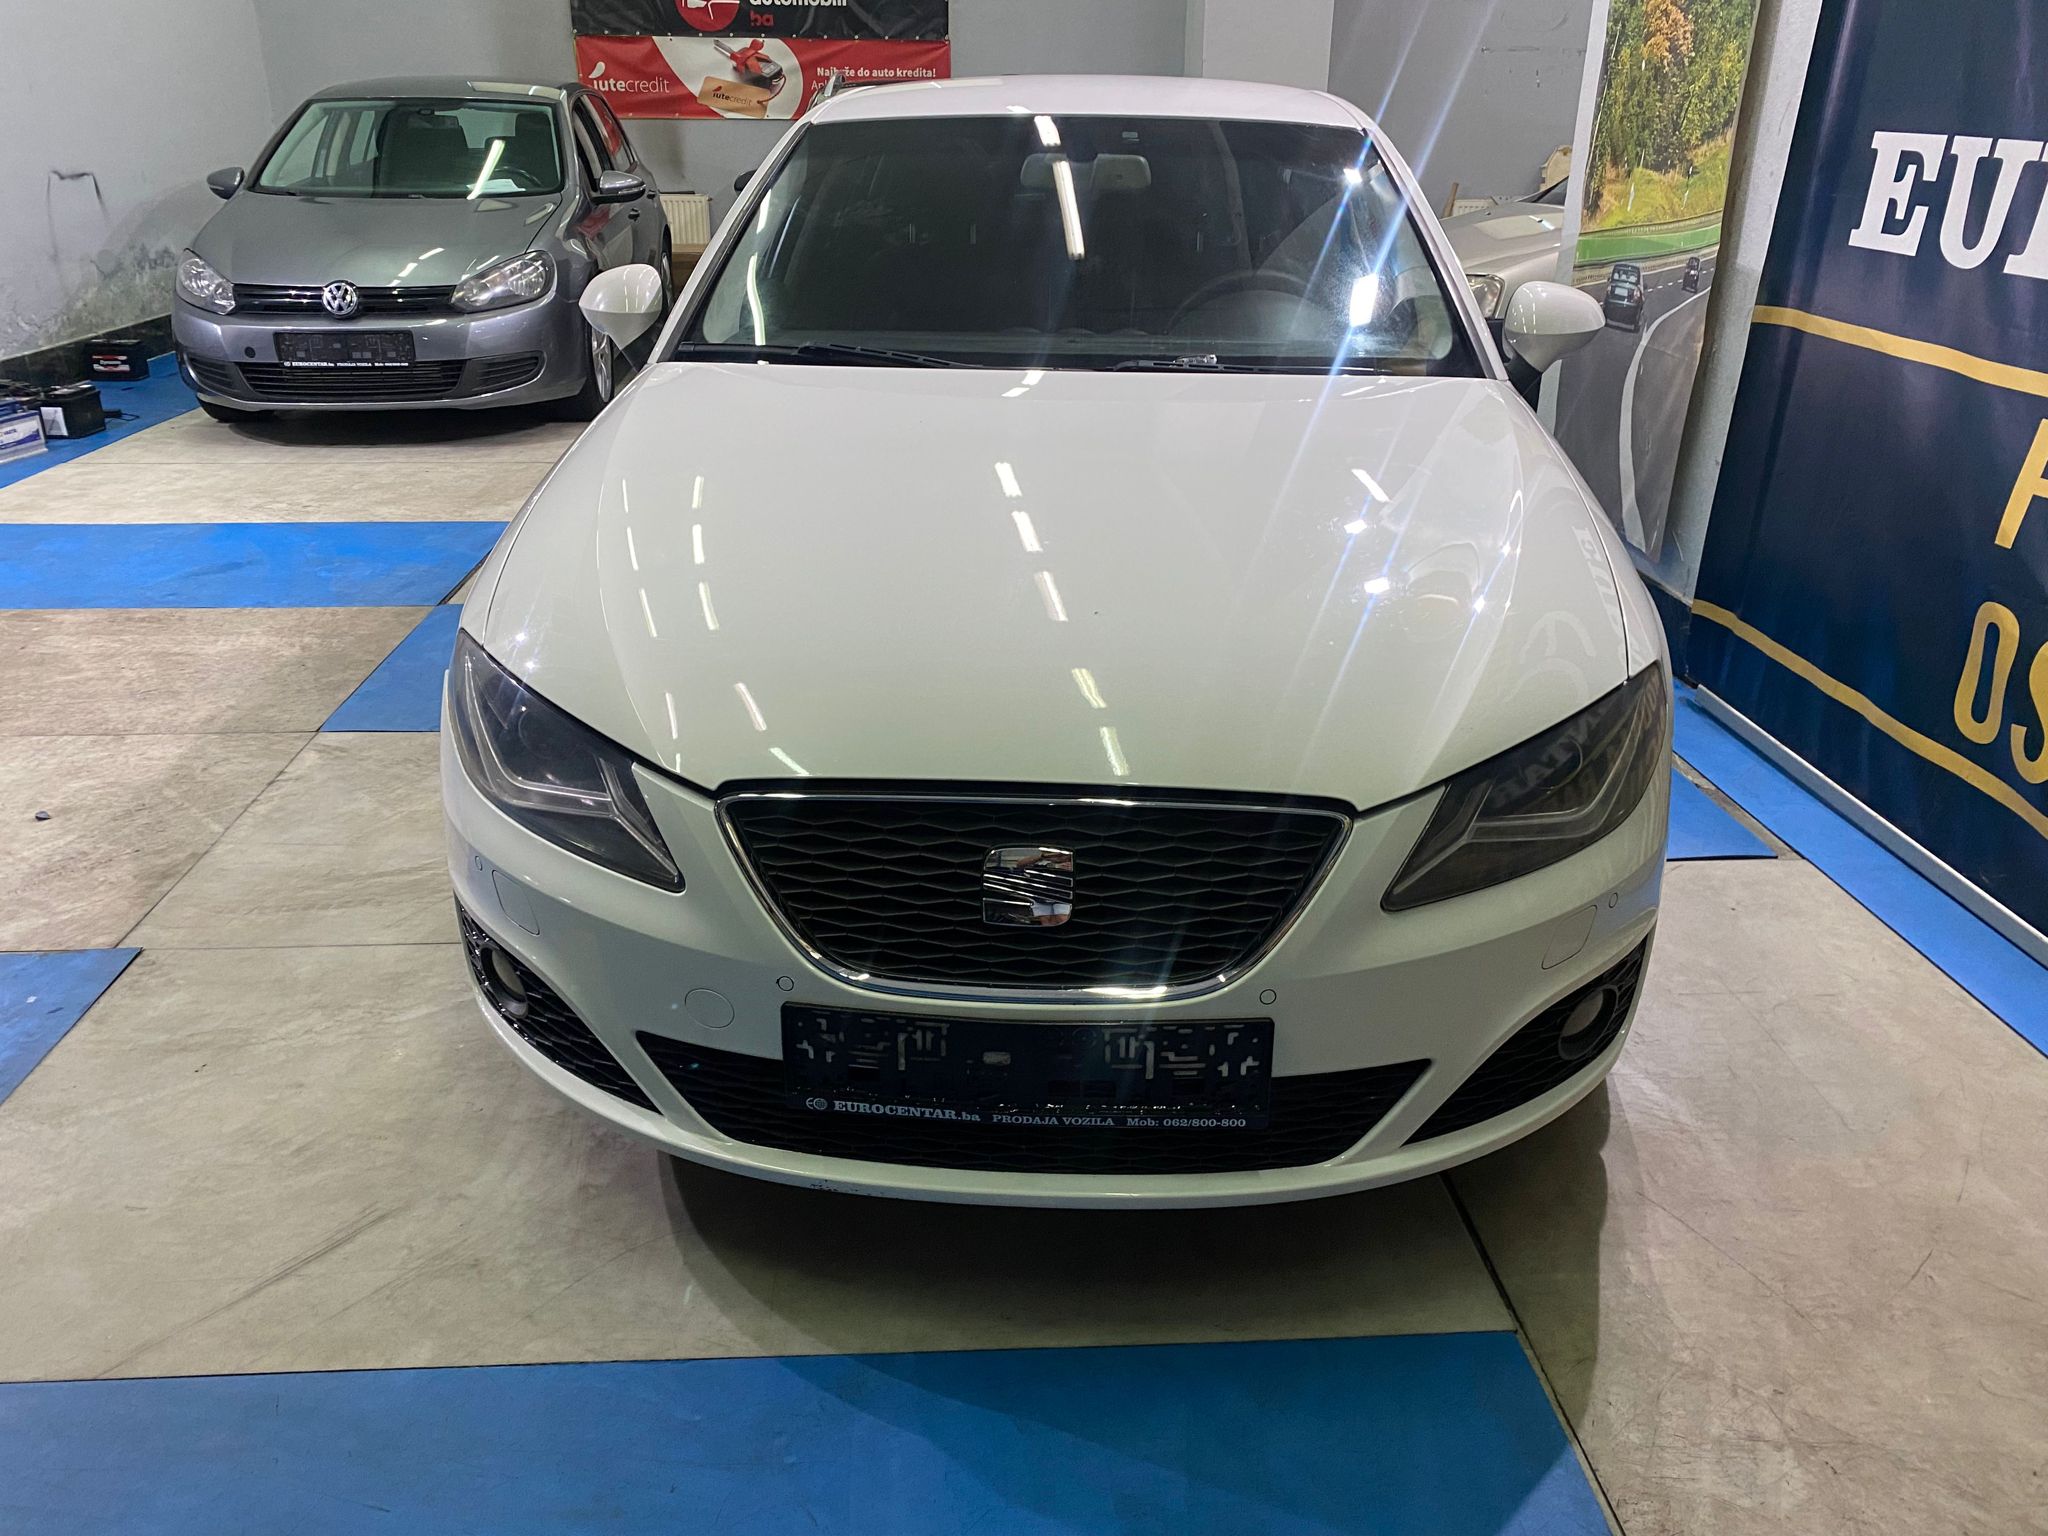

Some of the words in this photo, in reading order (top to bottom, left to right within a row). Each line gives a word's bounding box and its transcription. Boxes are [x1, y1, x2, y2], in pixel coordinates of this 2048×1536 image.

[857, 67, 870, 77] do
[872, 68, 895, 78] auto
[896, 67, 936, 78] kredita!
[592, 75, 670, 93] iutecredit
[833, 1100, 981, 1122] EUROCENTAR.ba
[991, 1114, 1059, 1126] PRODAJA
[1062, 1116, 1115, 1127] VOZILA
[1126, 1117, 1160, 1127] Mob:
[1163, 1117, 1247, 1128] 062/800-800
